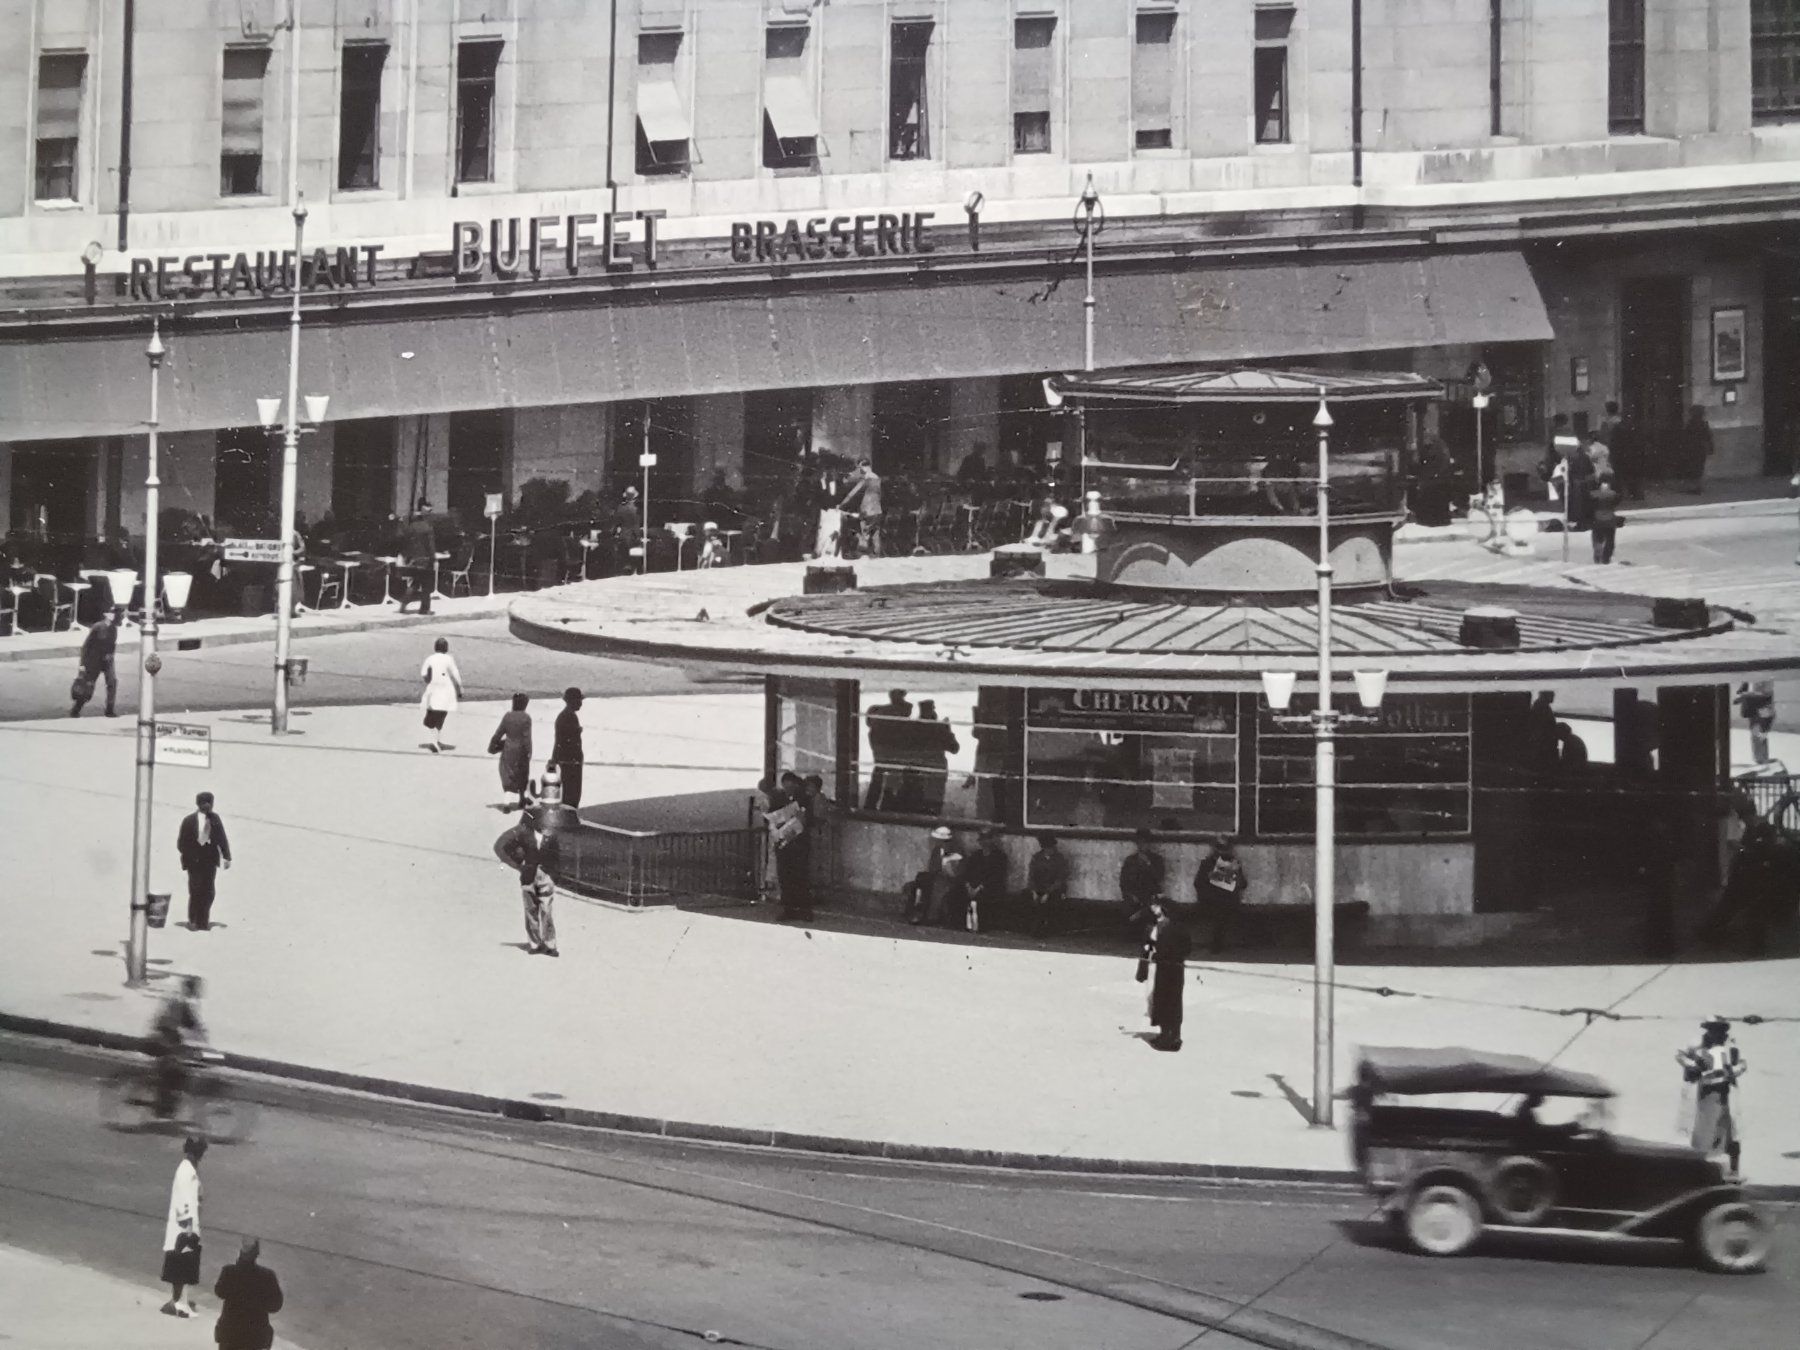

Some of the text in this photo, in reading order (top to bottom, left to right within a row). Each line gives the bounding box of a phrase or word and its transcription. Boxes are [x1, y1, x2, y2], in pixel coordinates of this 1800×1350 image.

[131, 209, 935, 301] RESTAURANT BUFFET BRASSERIE
